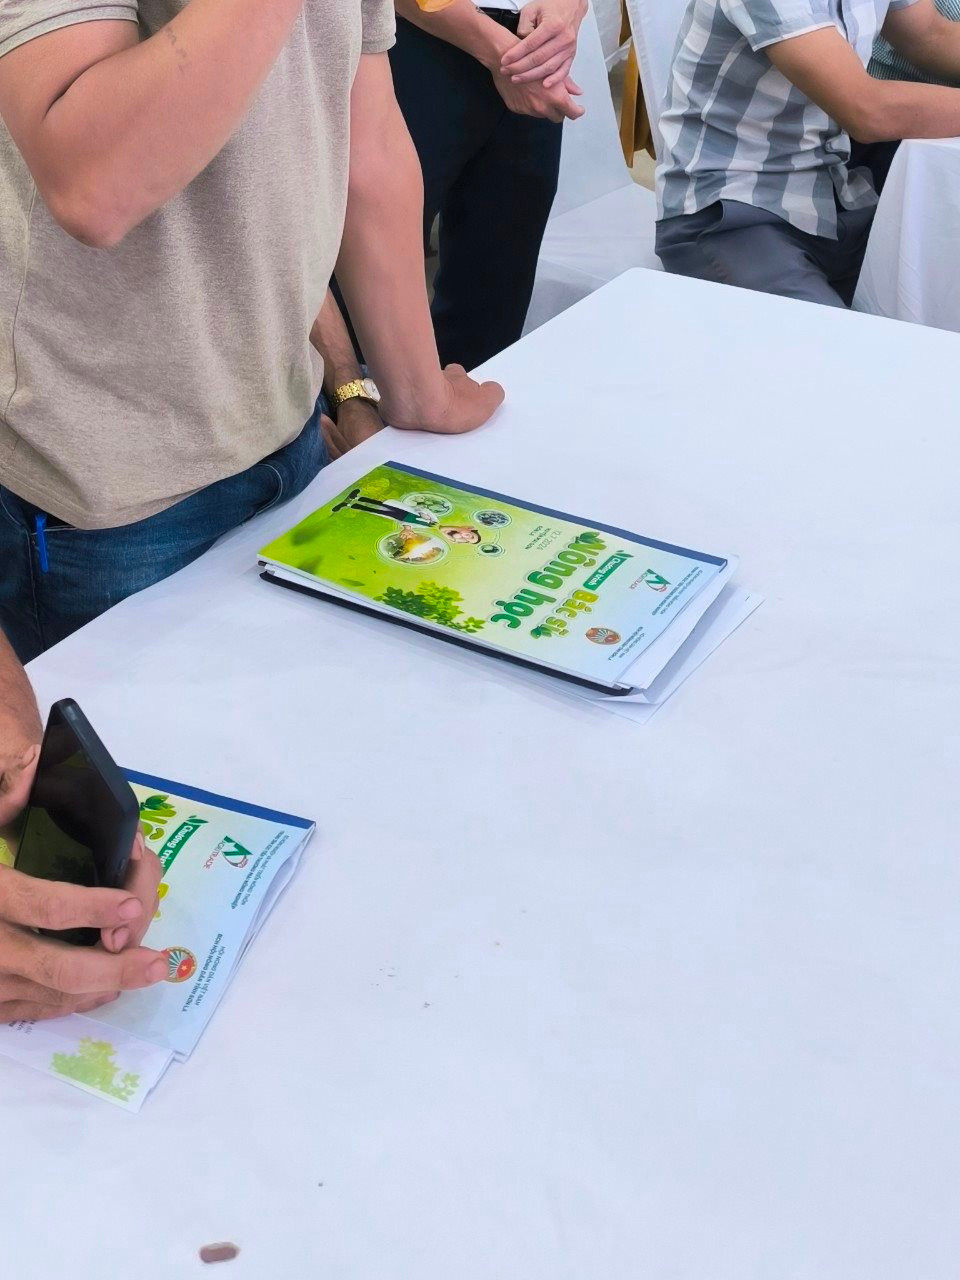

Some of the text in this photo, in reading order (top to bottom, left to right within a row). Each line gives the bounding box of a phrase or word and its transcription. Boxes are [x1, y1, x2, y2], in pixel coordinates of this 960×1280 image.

[489, 540, 609, 630] Nông học
[555, 589, 599, 619] Bác
